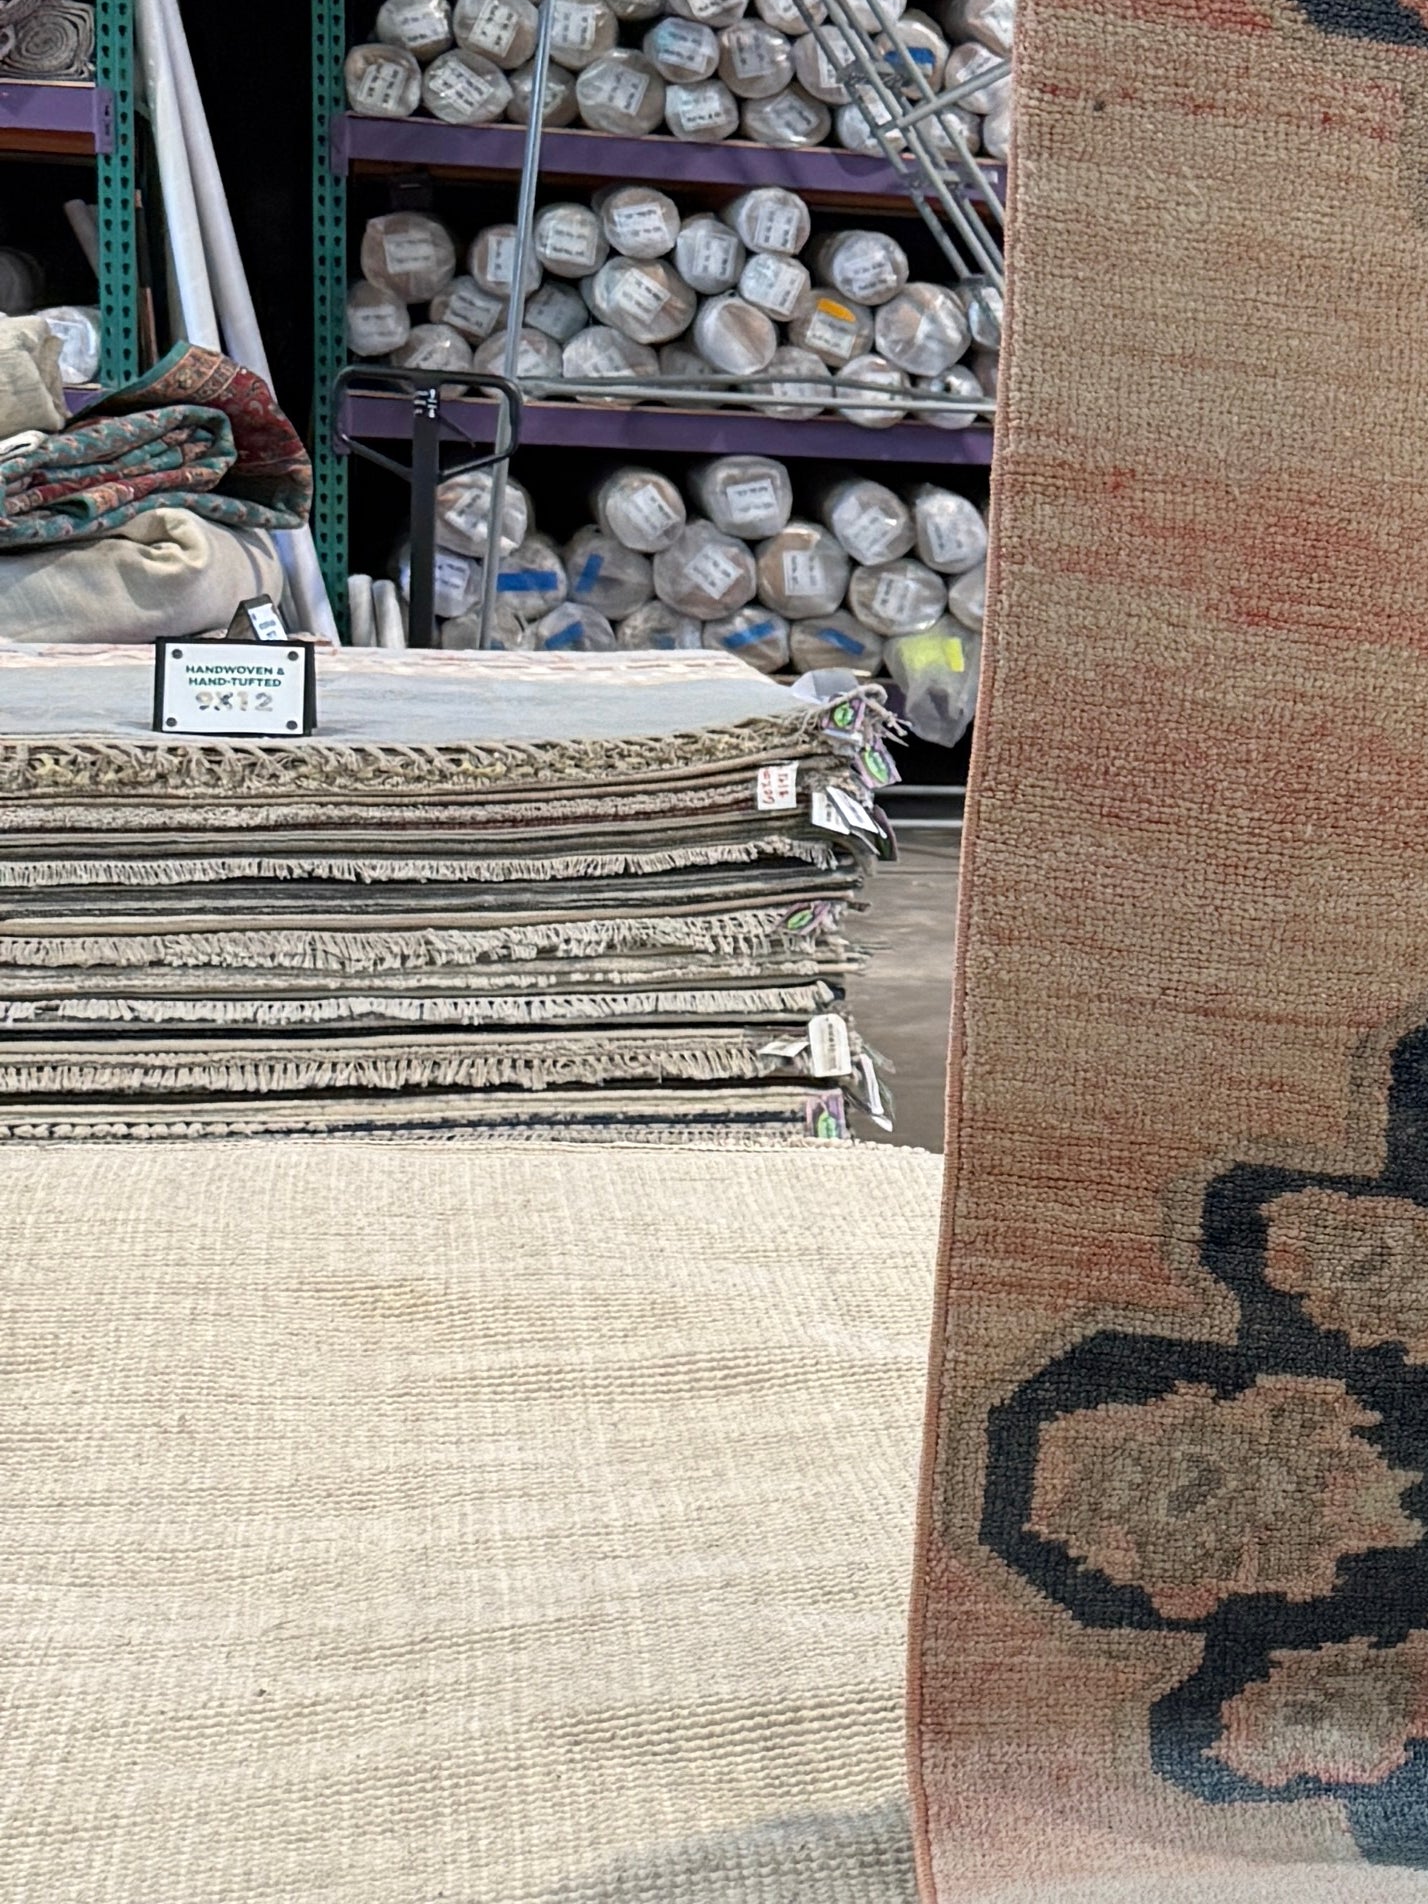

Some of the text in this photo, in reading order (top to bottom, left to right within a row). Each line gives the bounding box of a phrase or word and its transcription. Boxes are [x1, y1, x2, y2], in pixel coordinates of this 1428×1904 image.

[185, 664, 285, 676] HANDWOVEN &
[188, 677, 282, 687] HAND-TUFTED
